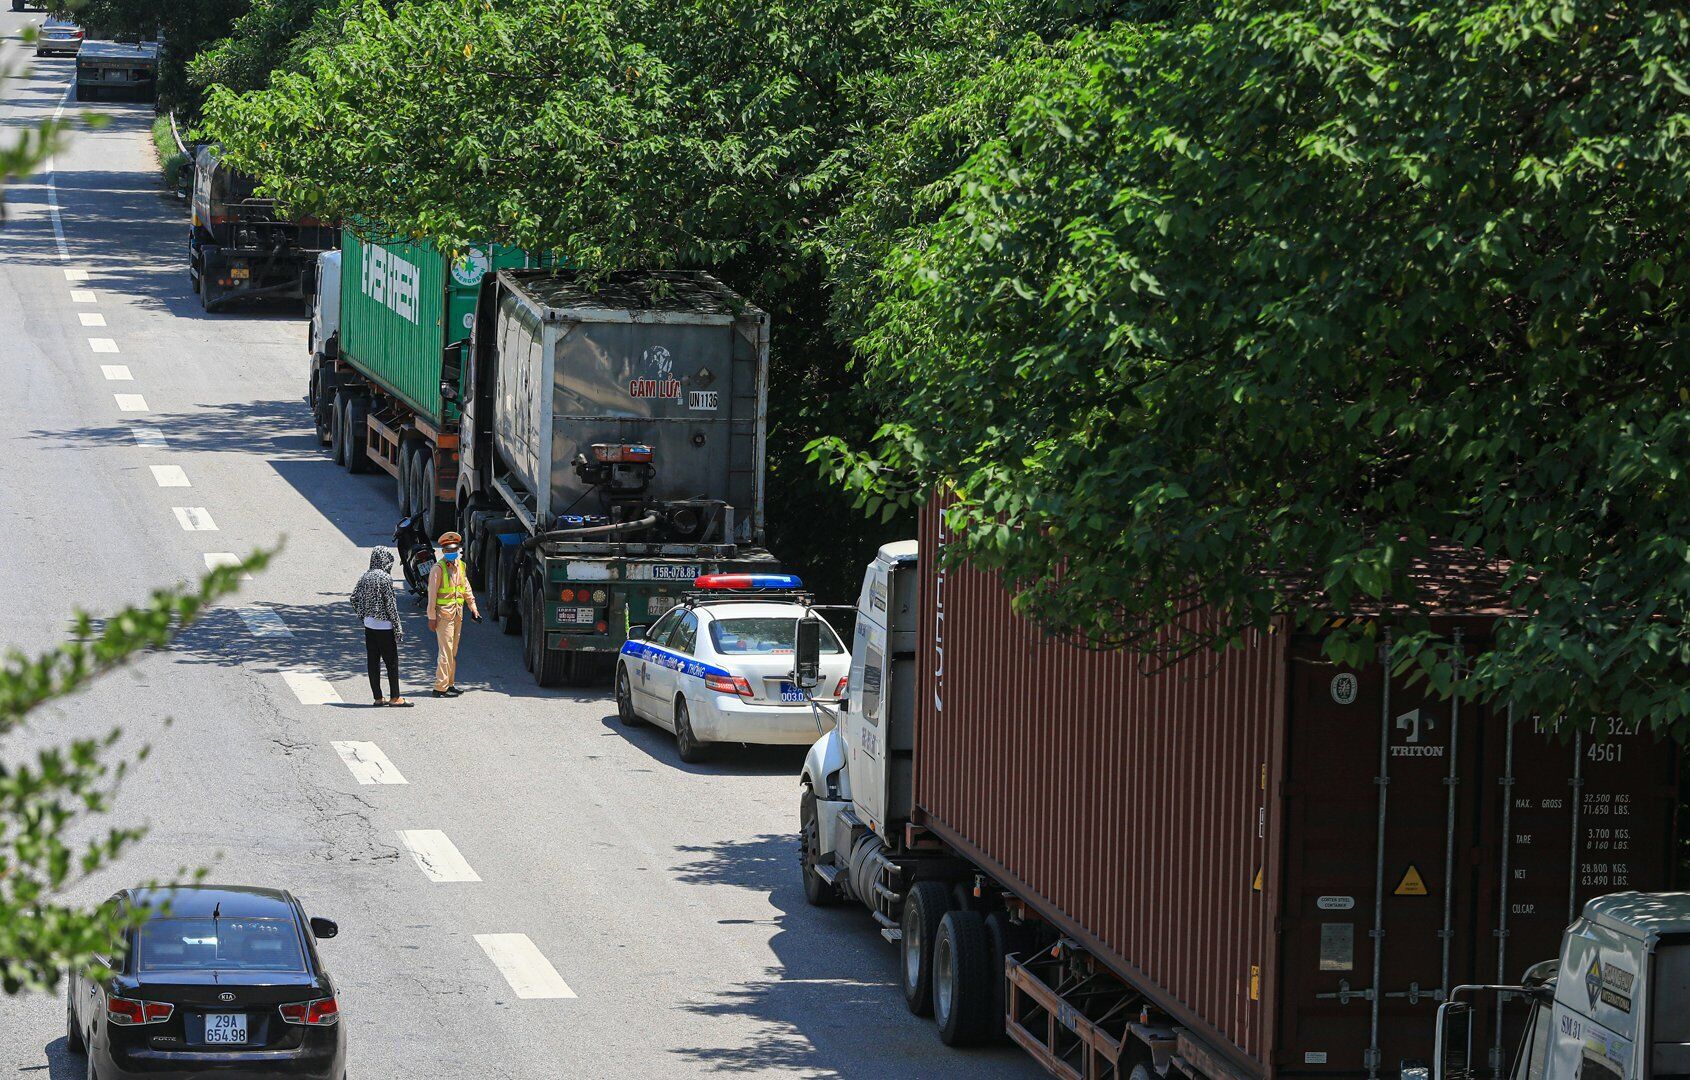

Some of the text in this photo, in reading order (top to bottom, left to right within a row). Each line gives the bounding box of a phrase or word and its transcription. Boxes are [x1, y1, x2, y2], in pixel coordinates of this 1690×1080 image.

[1390, 746, 1444, 757] TRITON
[1587, 743, 1622, 761] 45G1
[1541, 799, 1562, 808] GROSS
[1516, 834, 1532, 844] TARE
[1514, 869, 1526, 879] NET
[215, 1015, 237, 1028] 29A
[207, 1029, 246, 1042] 654.98
